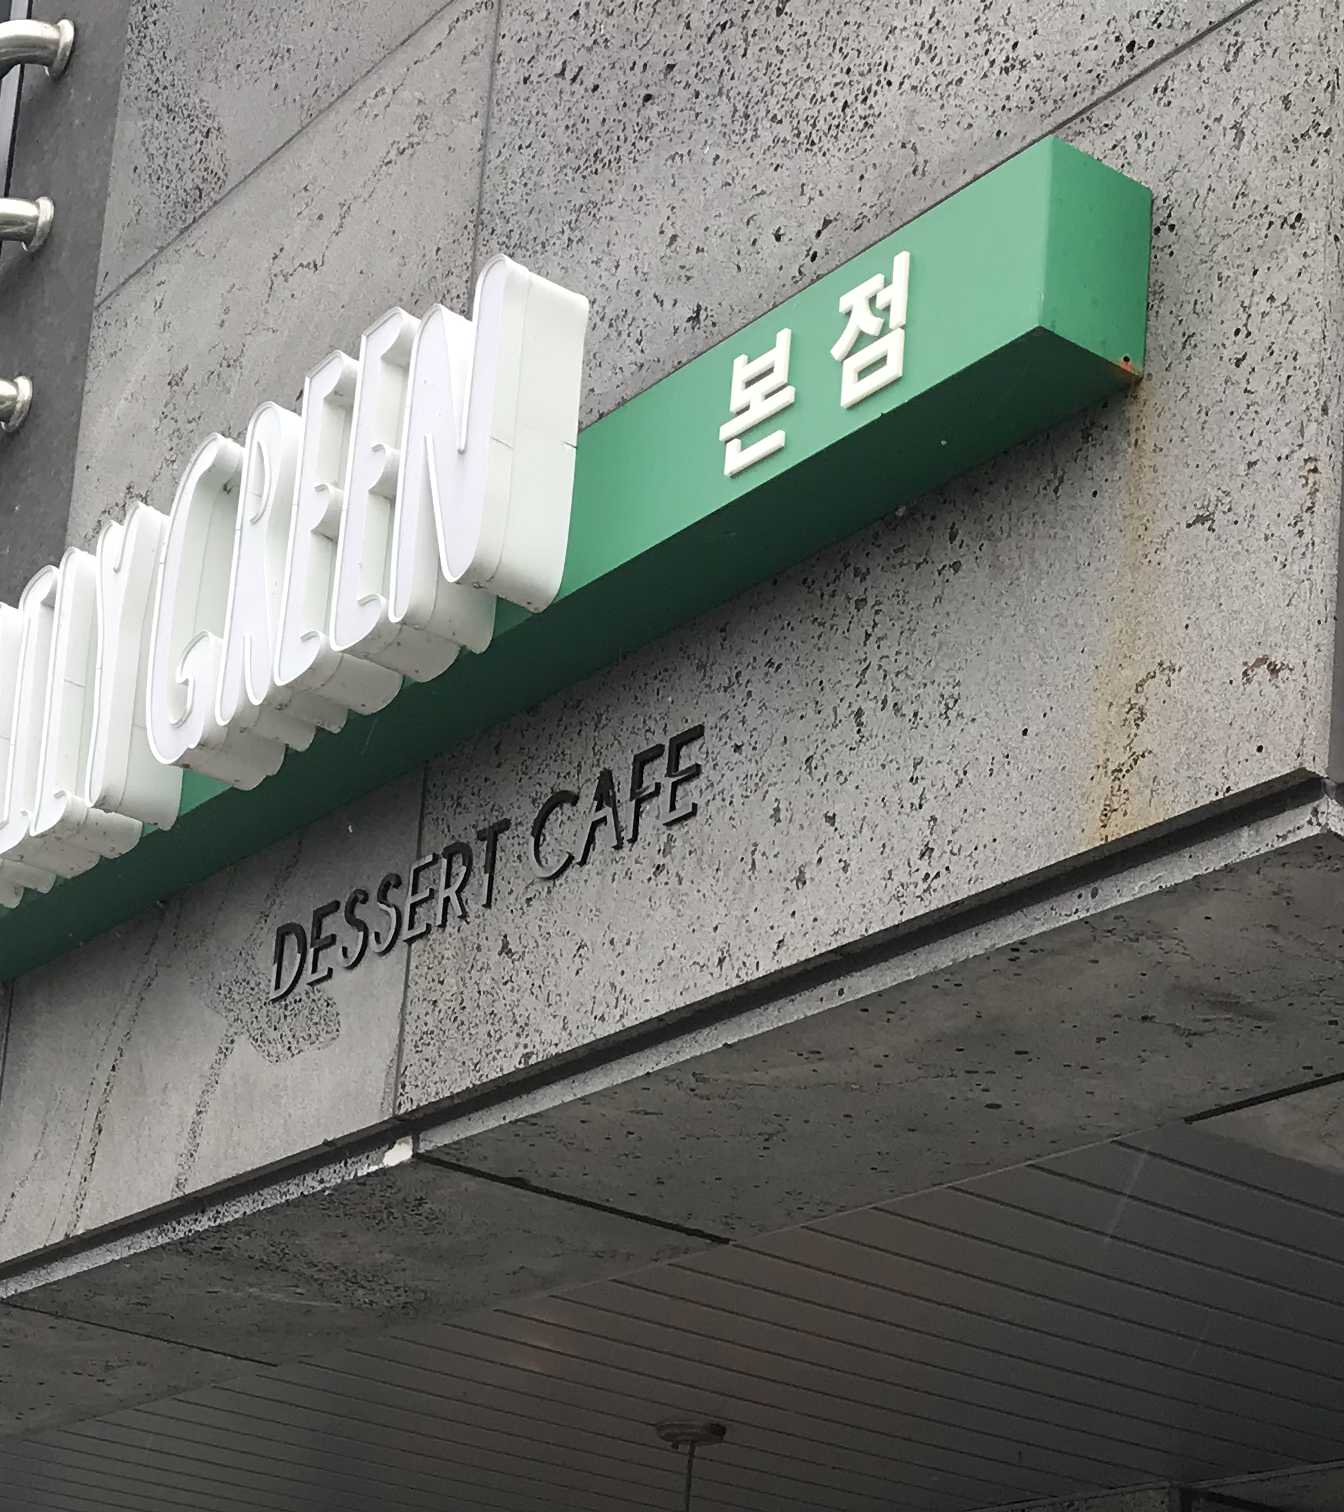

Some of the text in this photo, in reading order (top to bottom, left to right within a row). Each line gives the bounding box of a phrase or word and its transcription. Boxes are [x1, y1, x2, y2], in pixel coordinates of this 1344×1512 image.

[146, 254, 588, 778] GREEN
[270, 724, 705, 1001] DESSERT CAFE
